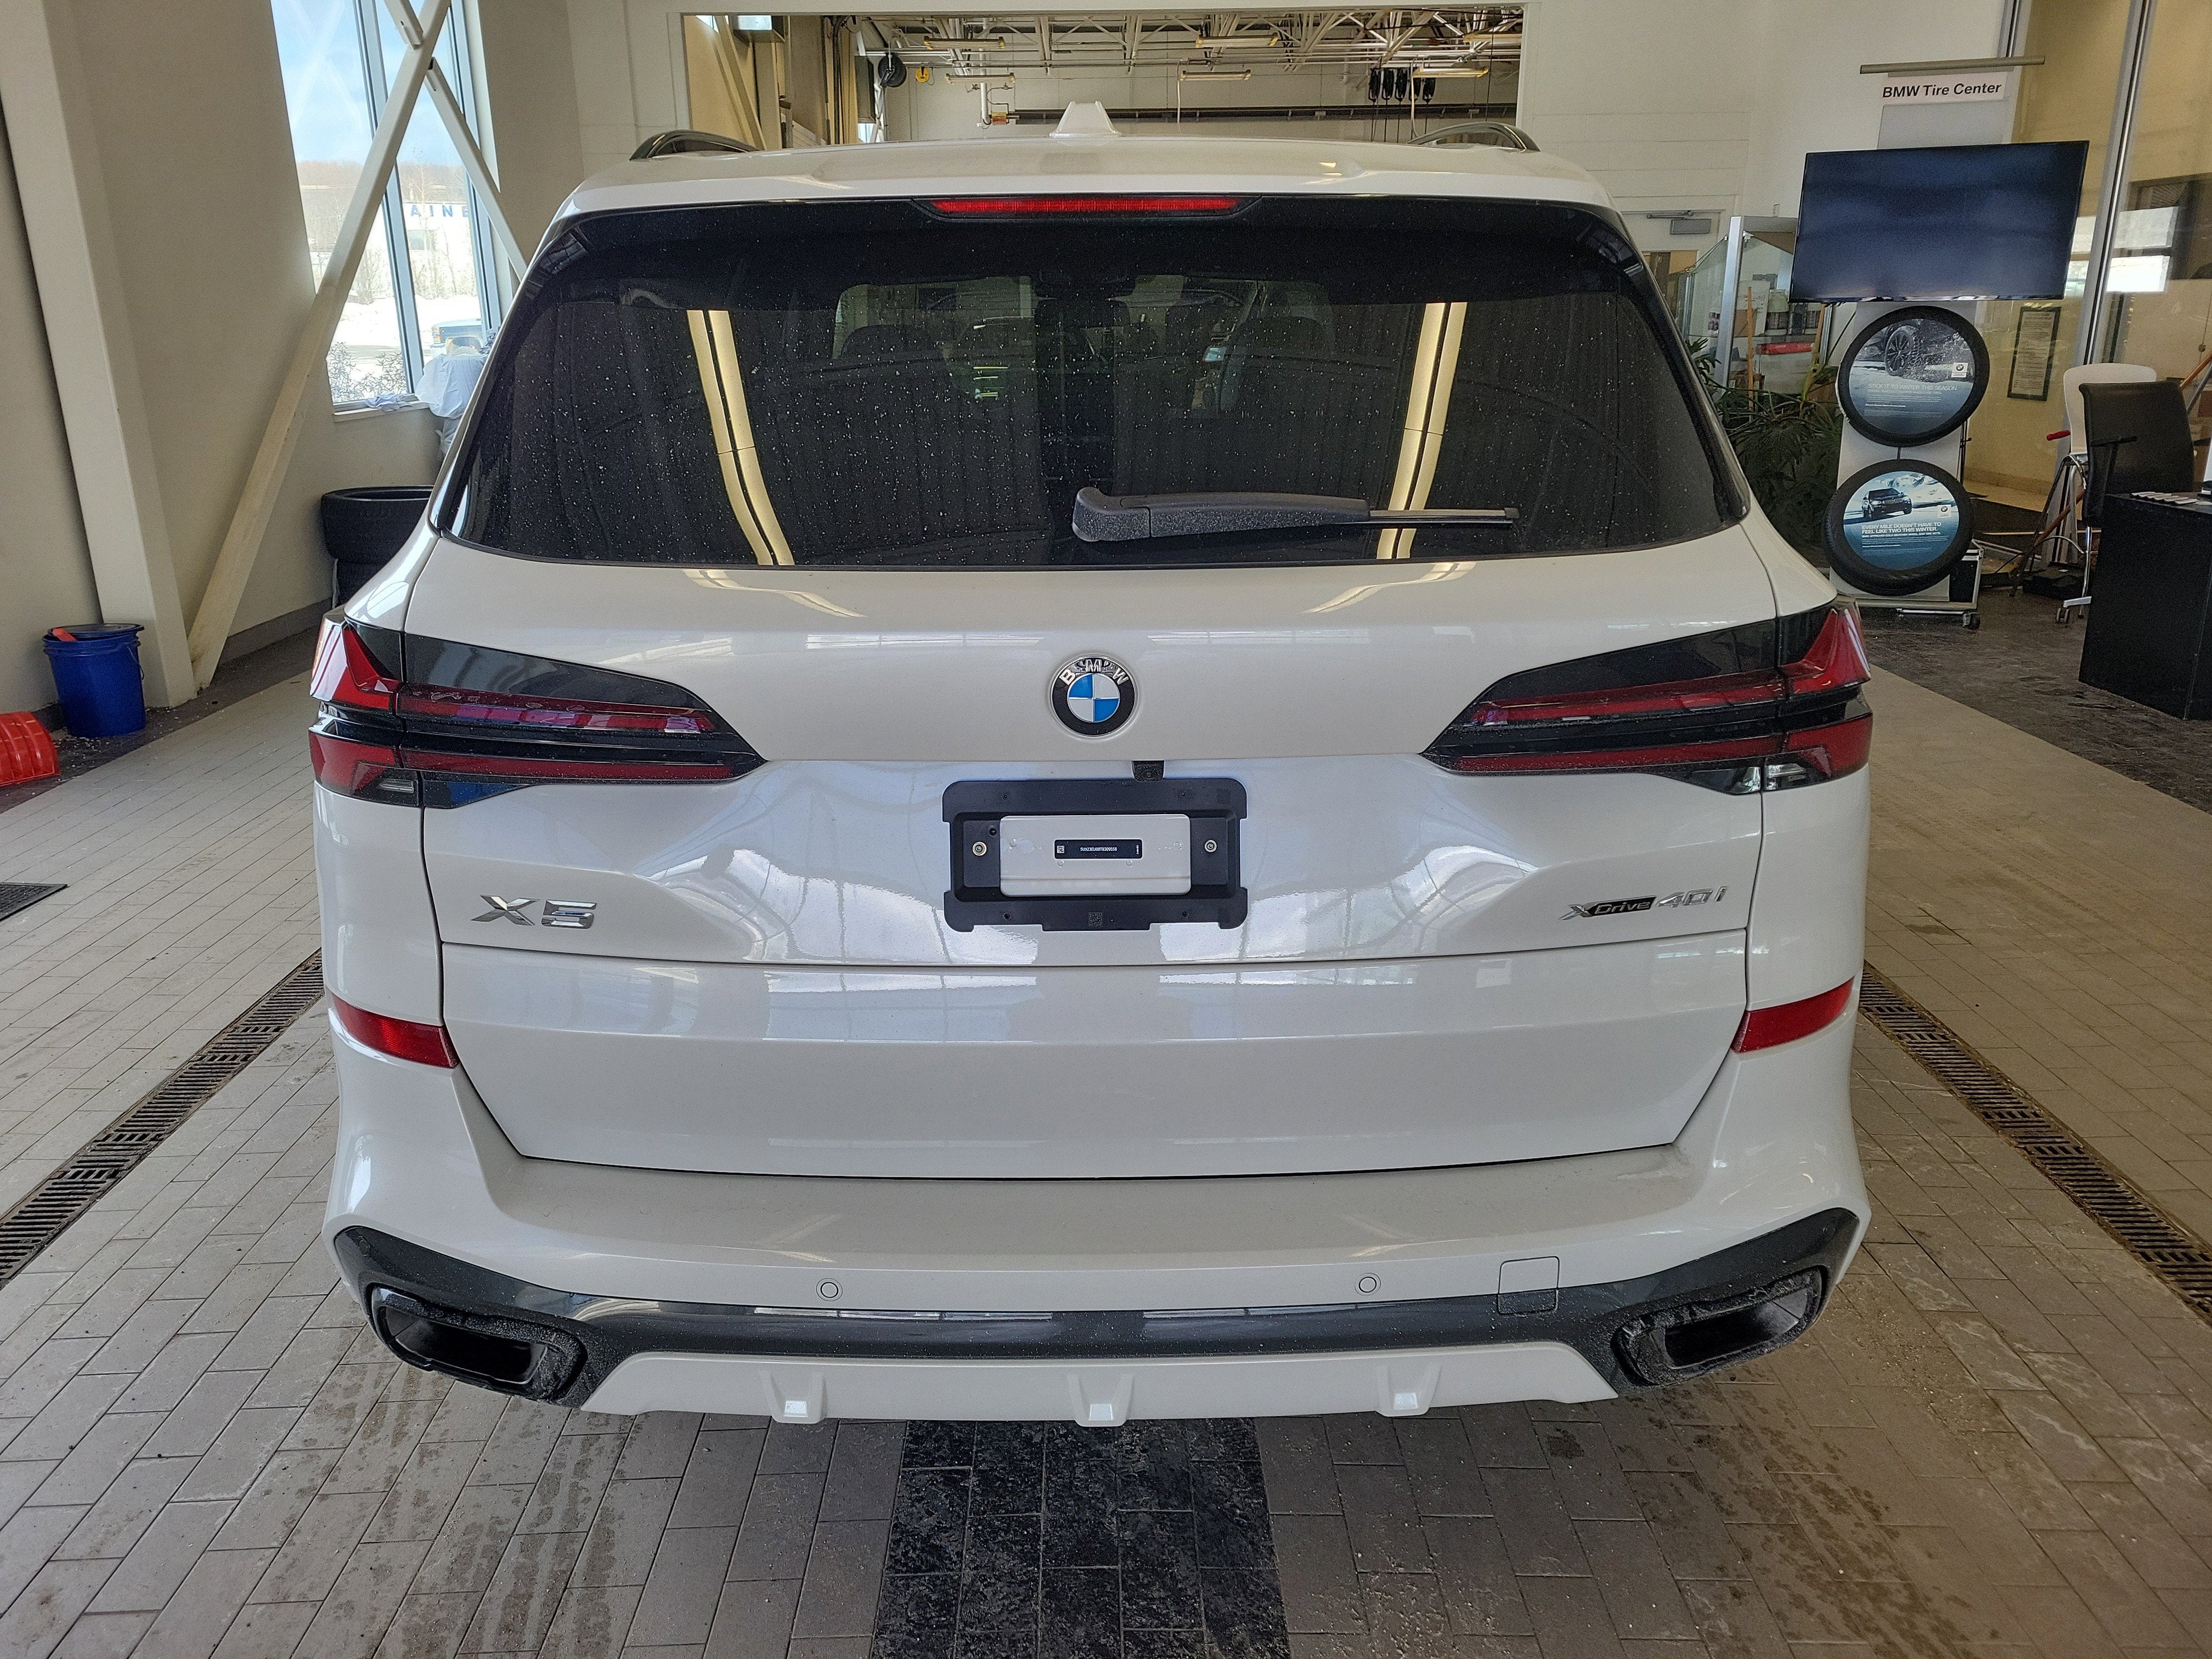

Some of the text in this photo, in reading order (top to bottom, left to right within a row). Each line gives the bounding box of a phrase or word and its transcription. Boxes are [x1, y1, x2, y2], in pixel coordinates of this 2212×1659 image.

[1882, 83, 2002, 98] BMW Tire Center
[1059, 659, 1129, 686] BMW
[470, 894, 597, 929] X5
